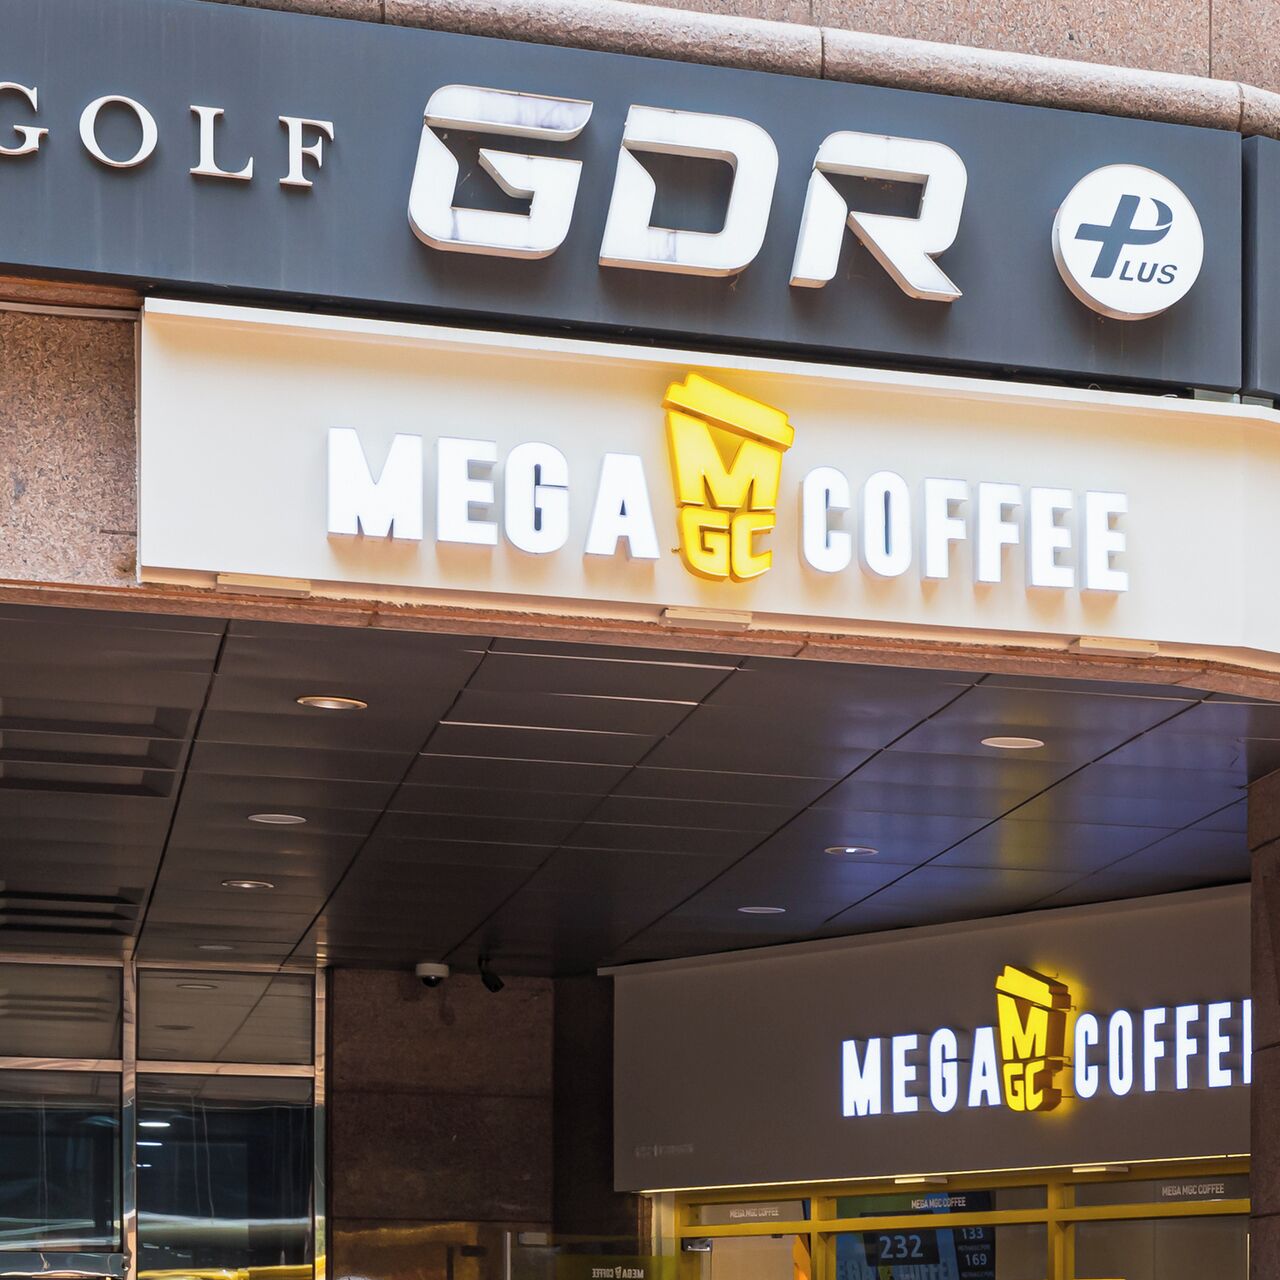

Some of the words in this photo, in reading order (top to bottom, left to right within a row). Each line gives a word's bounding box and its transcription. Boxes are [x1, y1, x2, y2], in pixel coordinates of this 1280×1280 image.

[0, 81, 336, 187] GOLF
[408, 83, 969, 302] GDR
[328, 427, 660, 562] MEGA
[801, 466, 1131, 594] COFFEE
[842, 1025, 1003, 1118] MEGA
[1073, 999, 1252, 1099] COFFE
[1161, 1185, 1181, 1197] MEGA
[1198, 1183, 1225, 1195] COFFEE
[879, 1234, 924, 1260] 232
[962, 1227, 984, 1240] 133
[965, 1253, 988, 1266] 169
